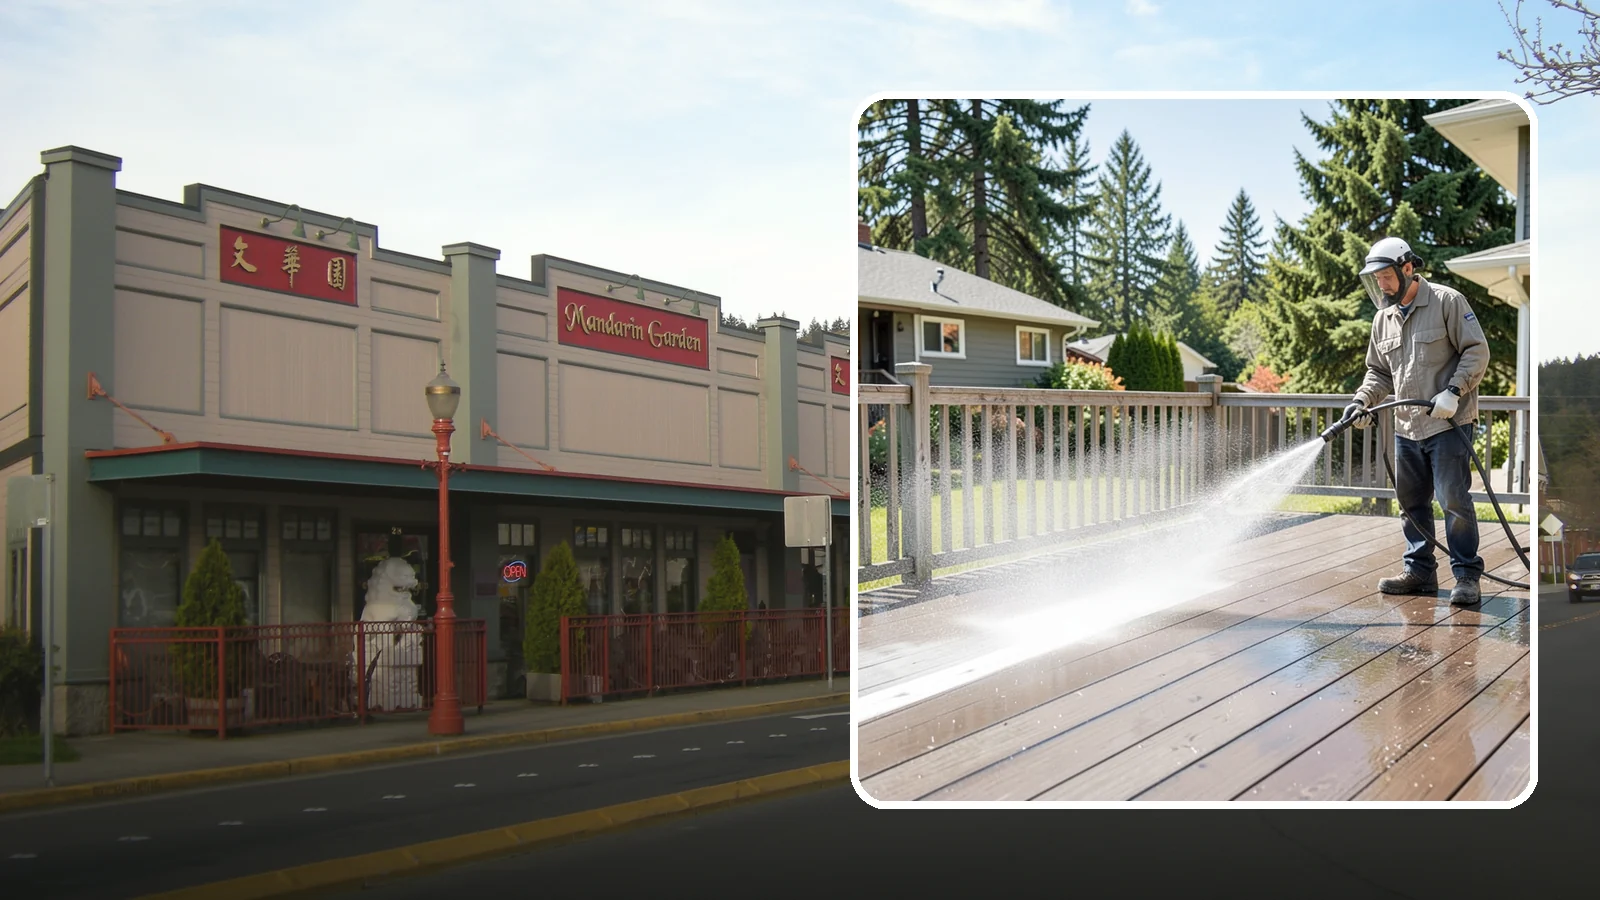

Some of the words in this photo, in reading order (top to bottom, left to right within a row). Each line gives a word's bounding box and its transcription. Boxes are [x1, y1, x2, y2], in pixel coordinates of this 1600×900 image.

[231, 235, 346, 290] 文華園
[564, 302, 644, 341] Mandarin
[648, 320, 701, 352] Garden
[503, 565, 527, 578] OPEN
